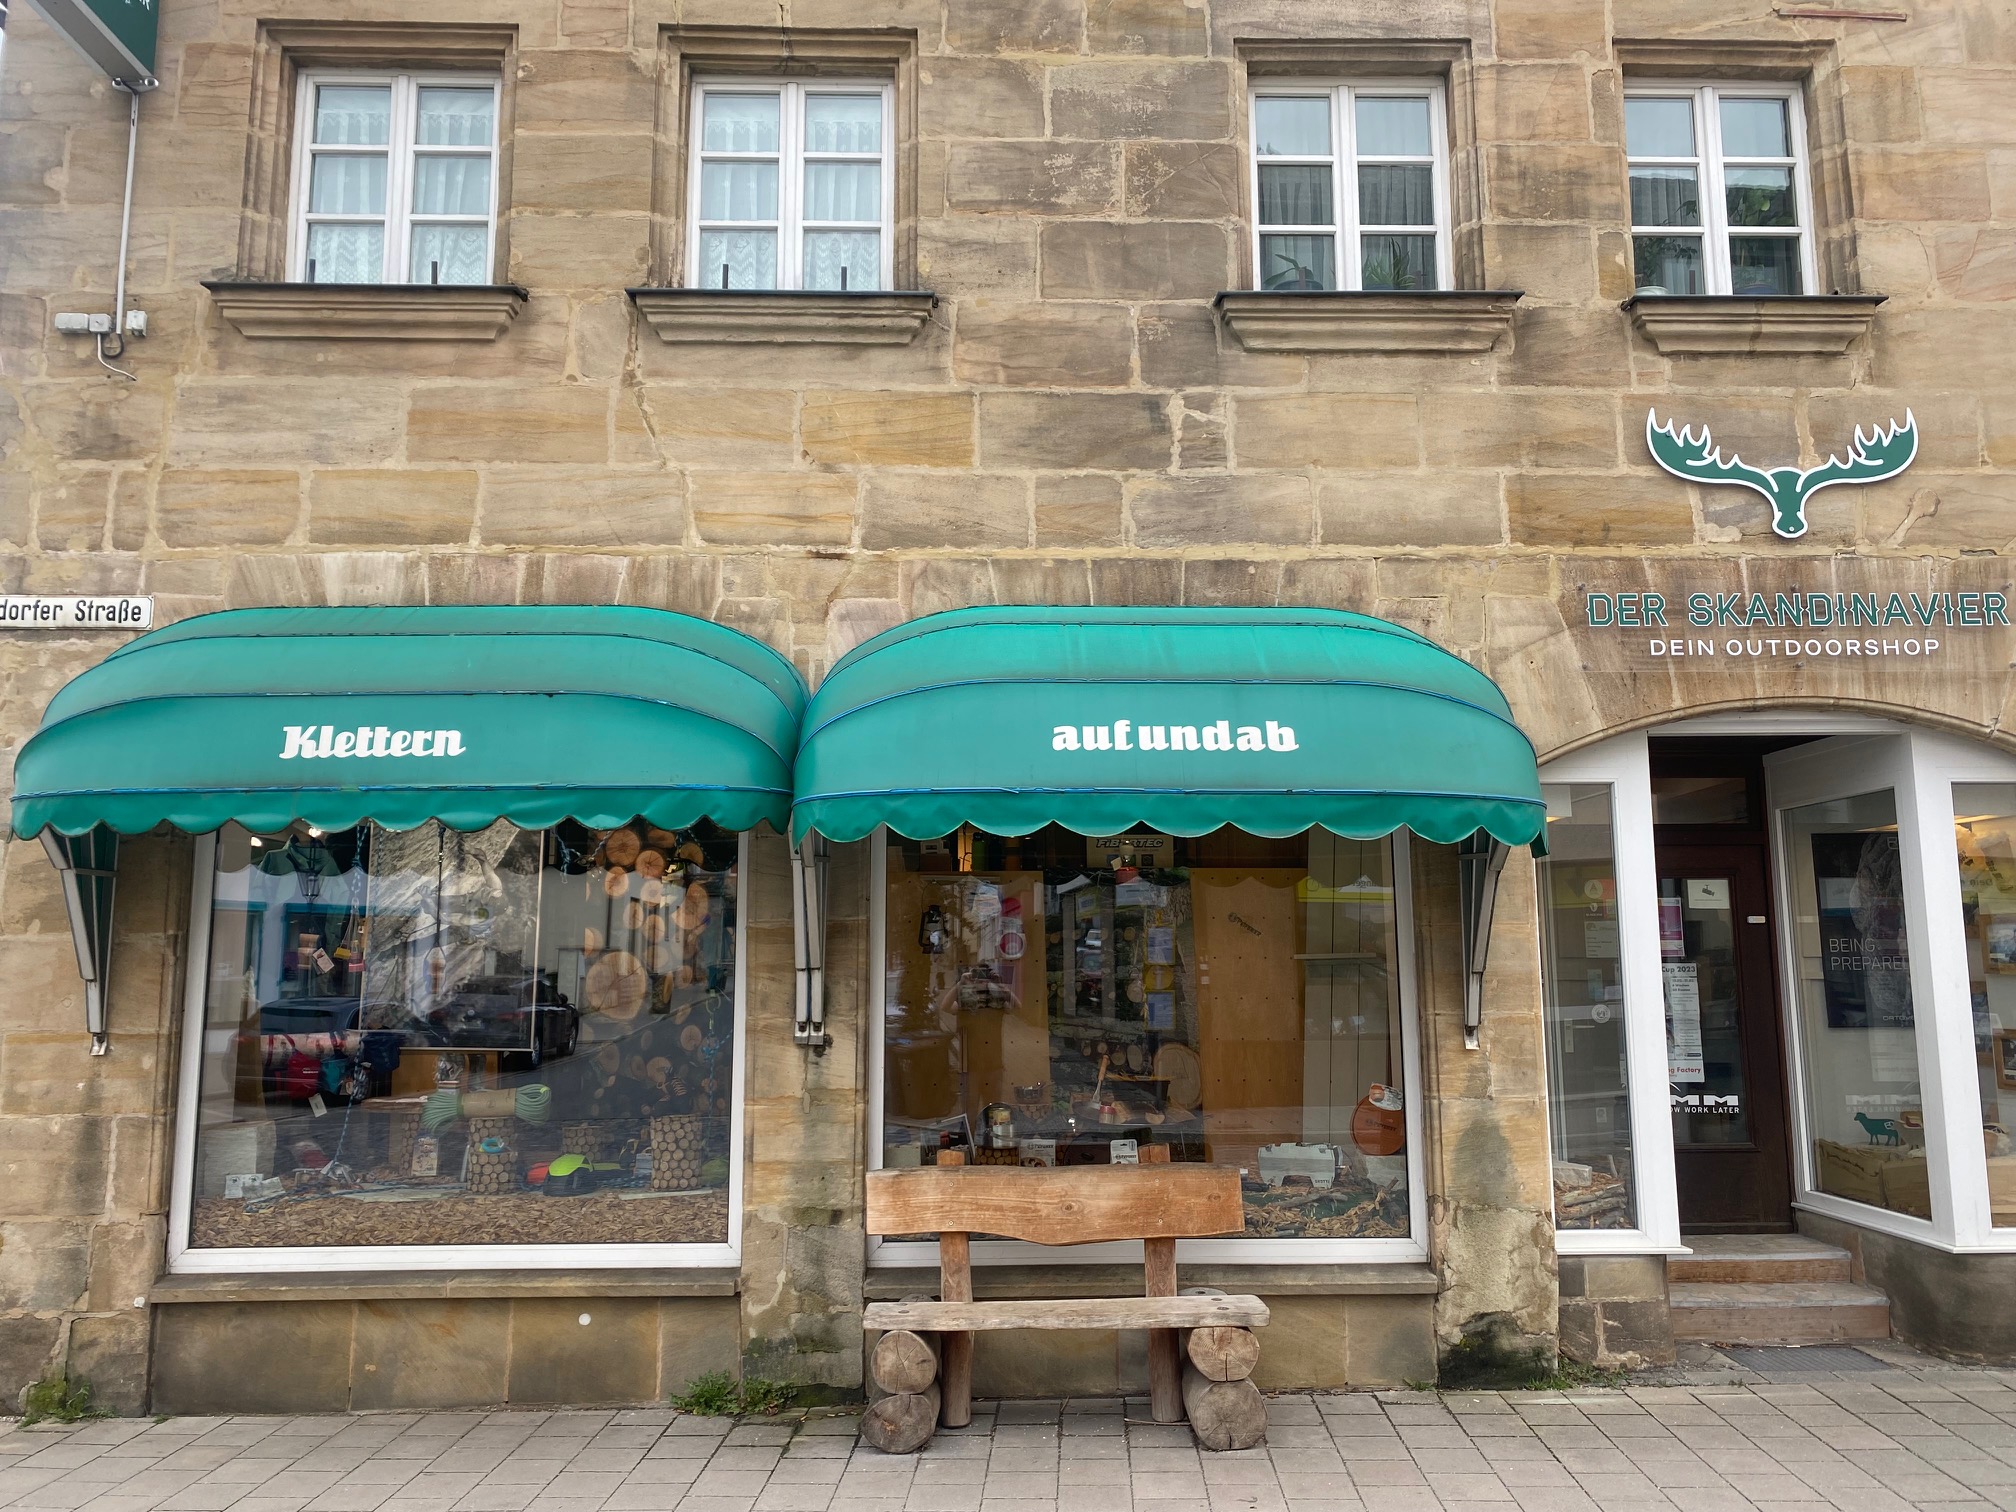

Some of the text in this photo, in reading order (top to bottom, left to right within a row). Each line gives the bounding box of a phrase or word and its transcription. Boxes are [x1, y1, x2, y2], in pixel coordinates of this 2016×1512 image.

[0, 599, 142, 623] dorfer Straße
[1585, 591, 2012, 627] DER SKANDINAVIER
[1649, 638, 1940, 656] DEIN OUTDOORSHOP
[278, 725, 467, 759] Klettern
[1829, 938, 1875, 953] BEING
[1712, 1106, 1740, 1114] LATER
